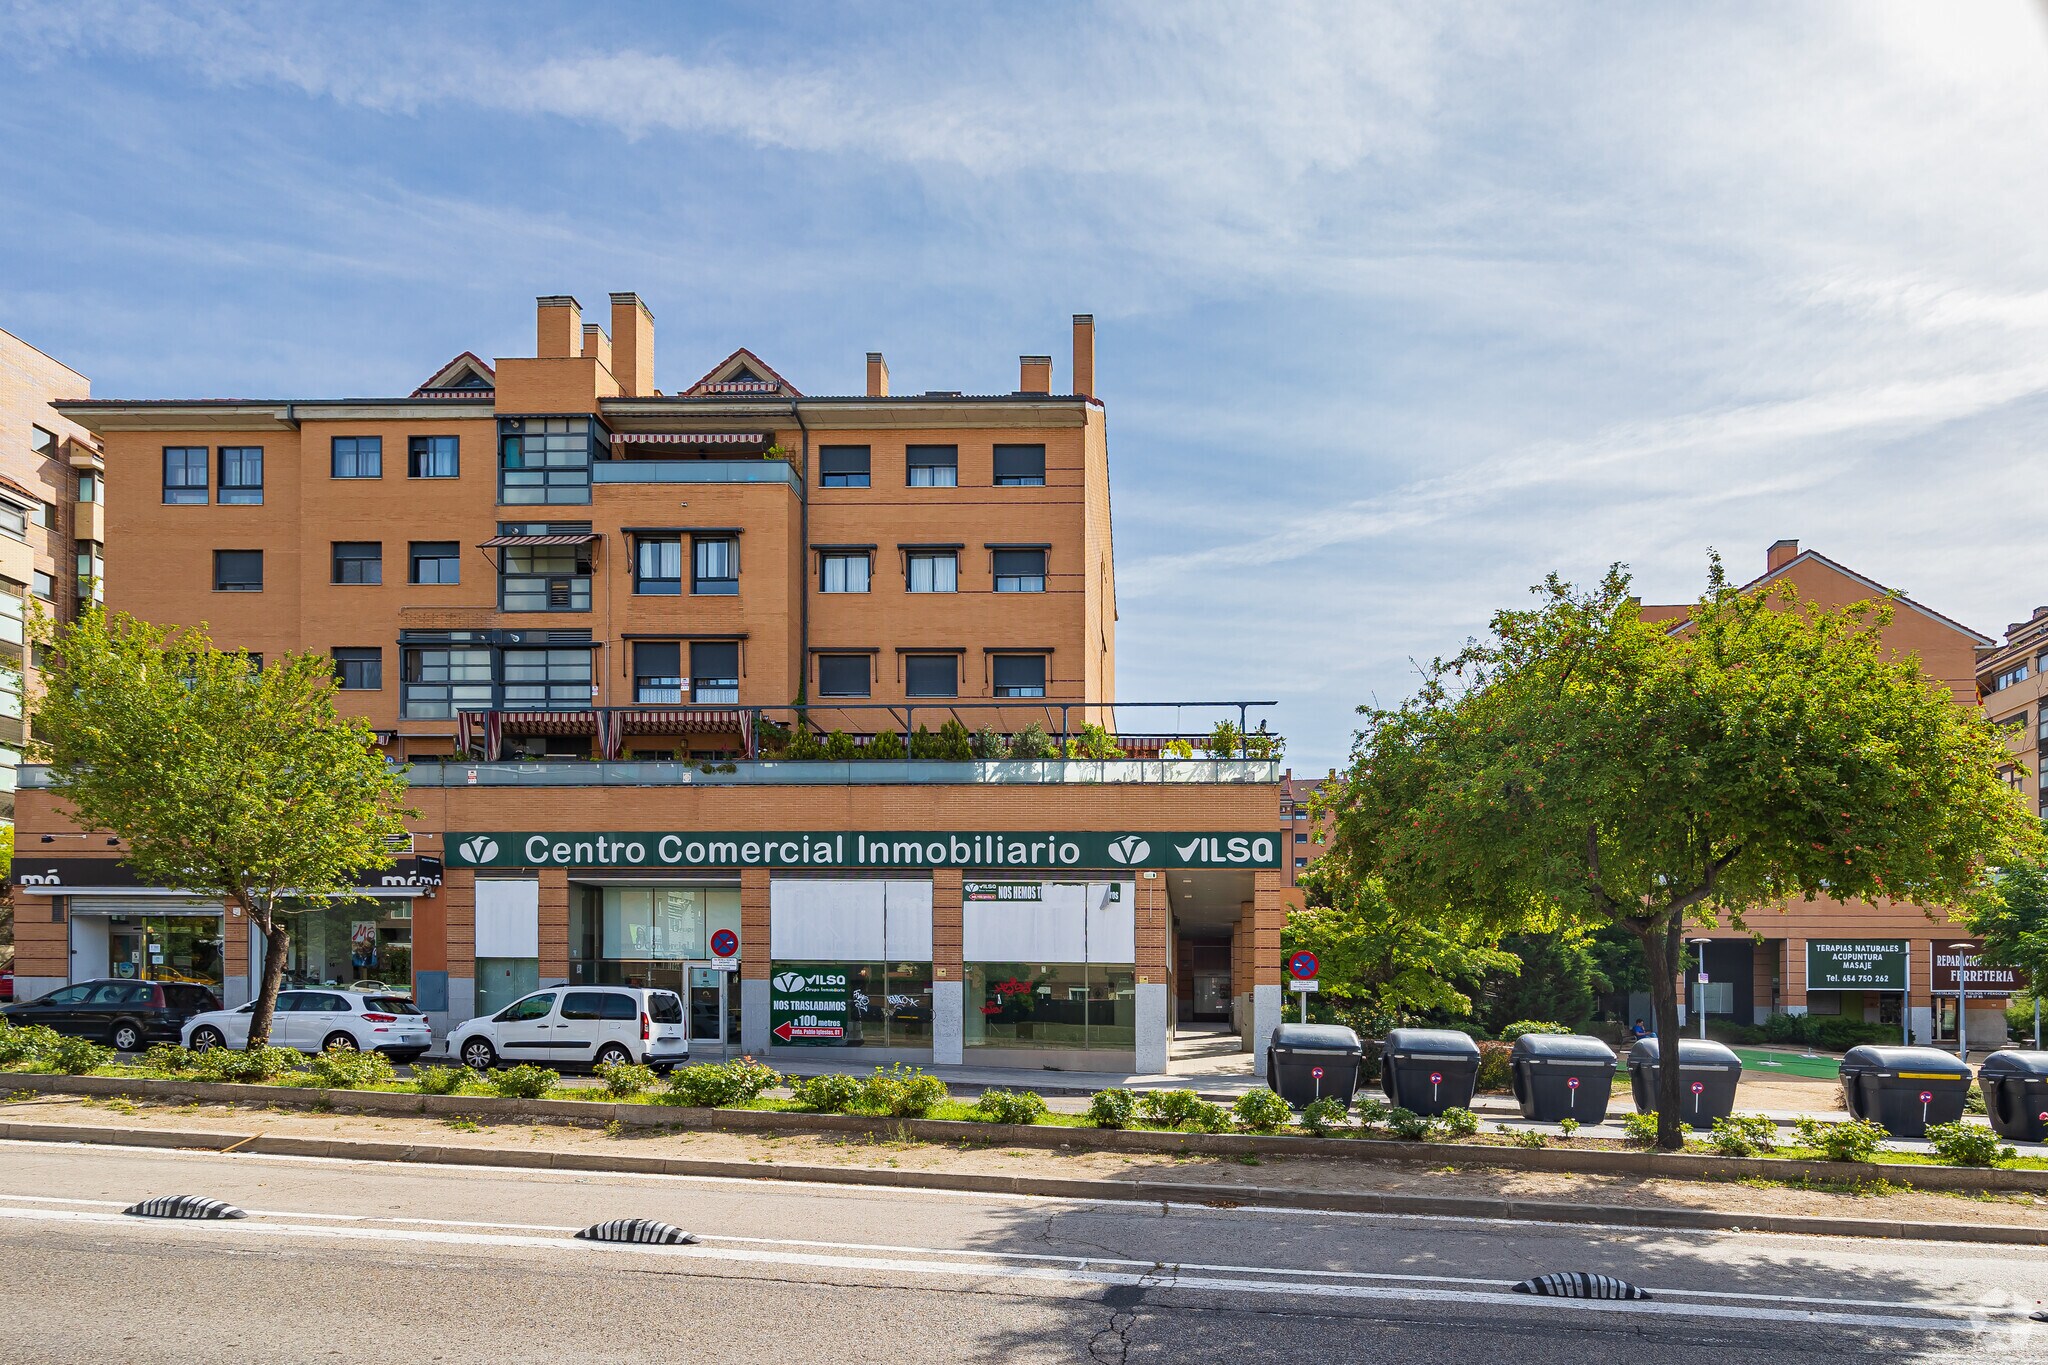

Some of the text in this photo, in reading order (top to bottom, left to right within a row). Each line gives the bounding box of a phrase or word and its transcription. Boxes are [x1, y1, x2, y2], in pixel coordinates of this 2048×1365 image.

[525, 834, 1080, 864] Centro Comercial Inmobiliario
[998, 885, 1013, 900] NOS
[1013, 885, 1036, 900] HEMOS
[1816, 944, 1899, 953] TERAPIAS NATURALES
[1832, 953, 1883, 961] ACUPUNTURA
[1843, 961, 1872, 970] MASAJE
[1826, 974, 1889, 983] Tel. 654 750 262
[773, 1000, 789, 1011] NOS
[790, 1000, 846, 1011] TRASLADAMOS
[793, 1015, 841, 1027] A 100 metros
